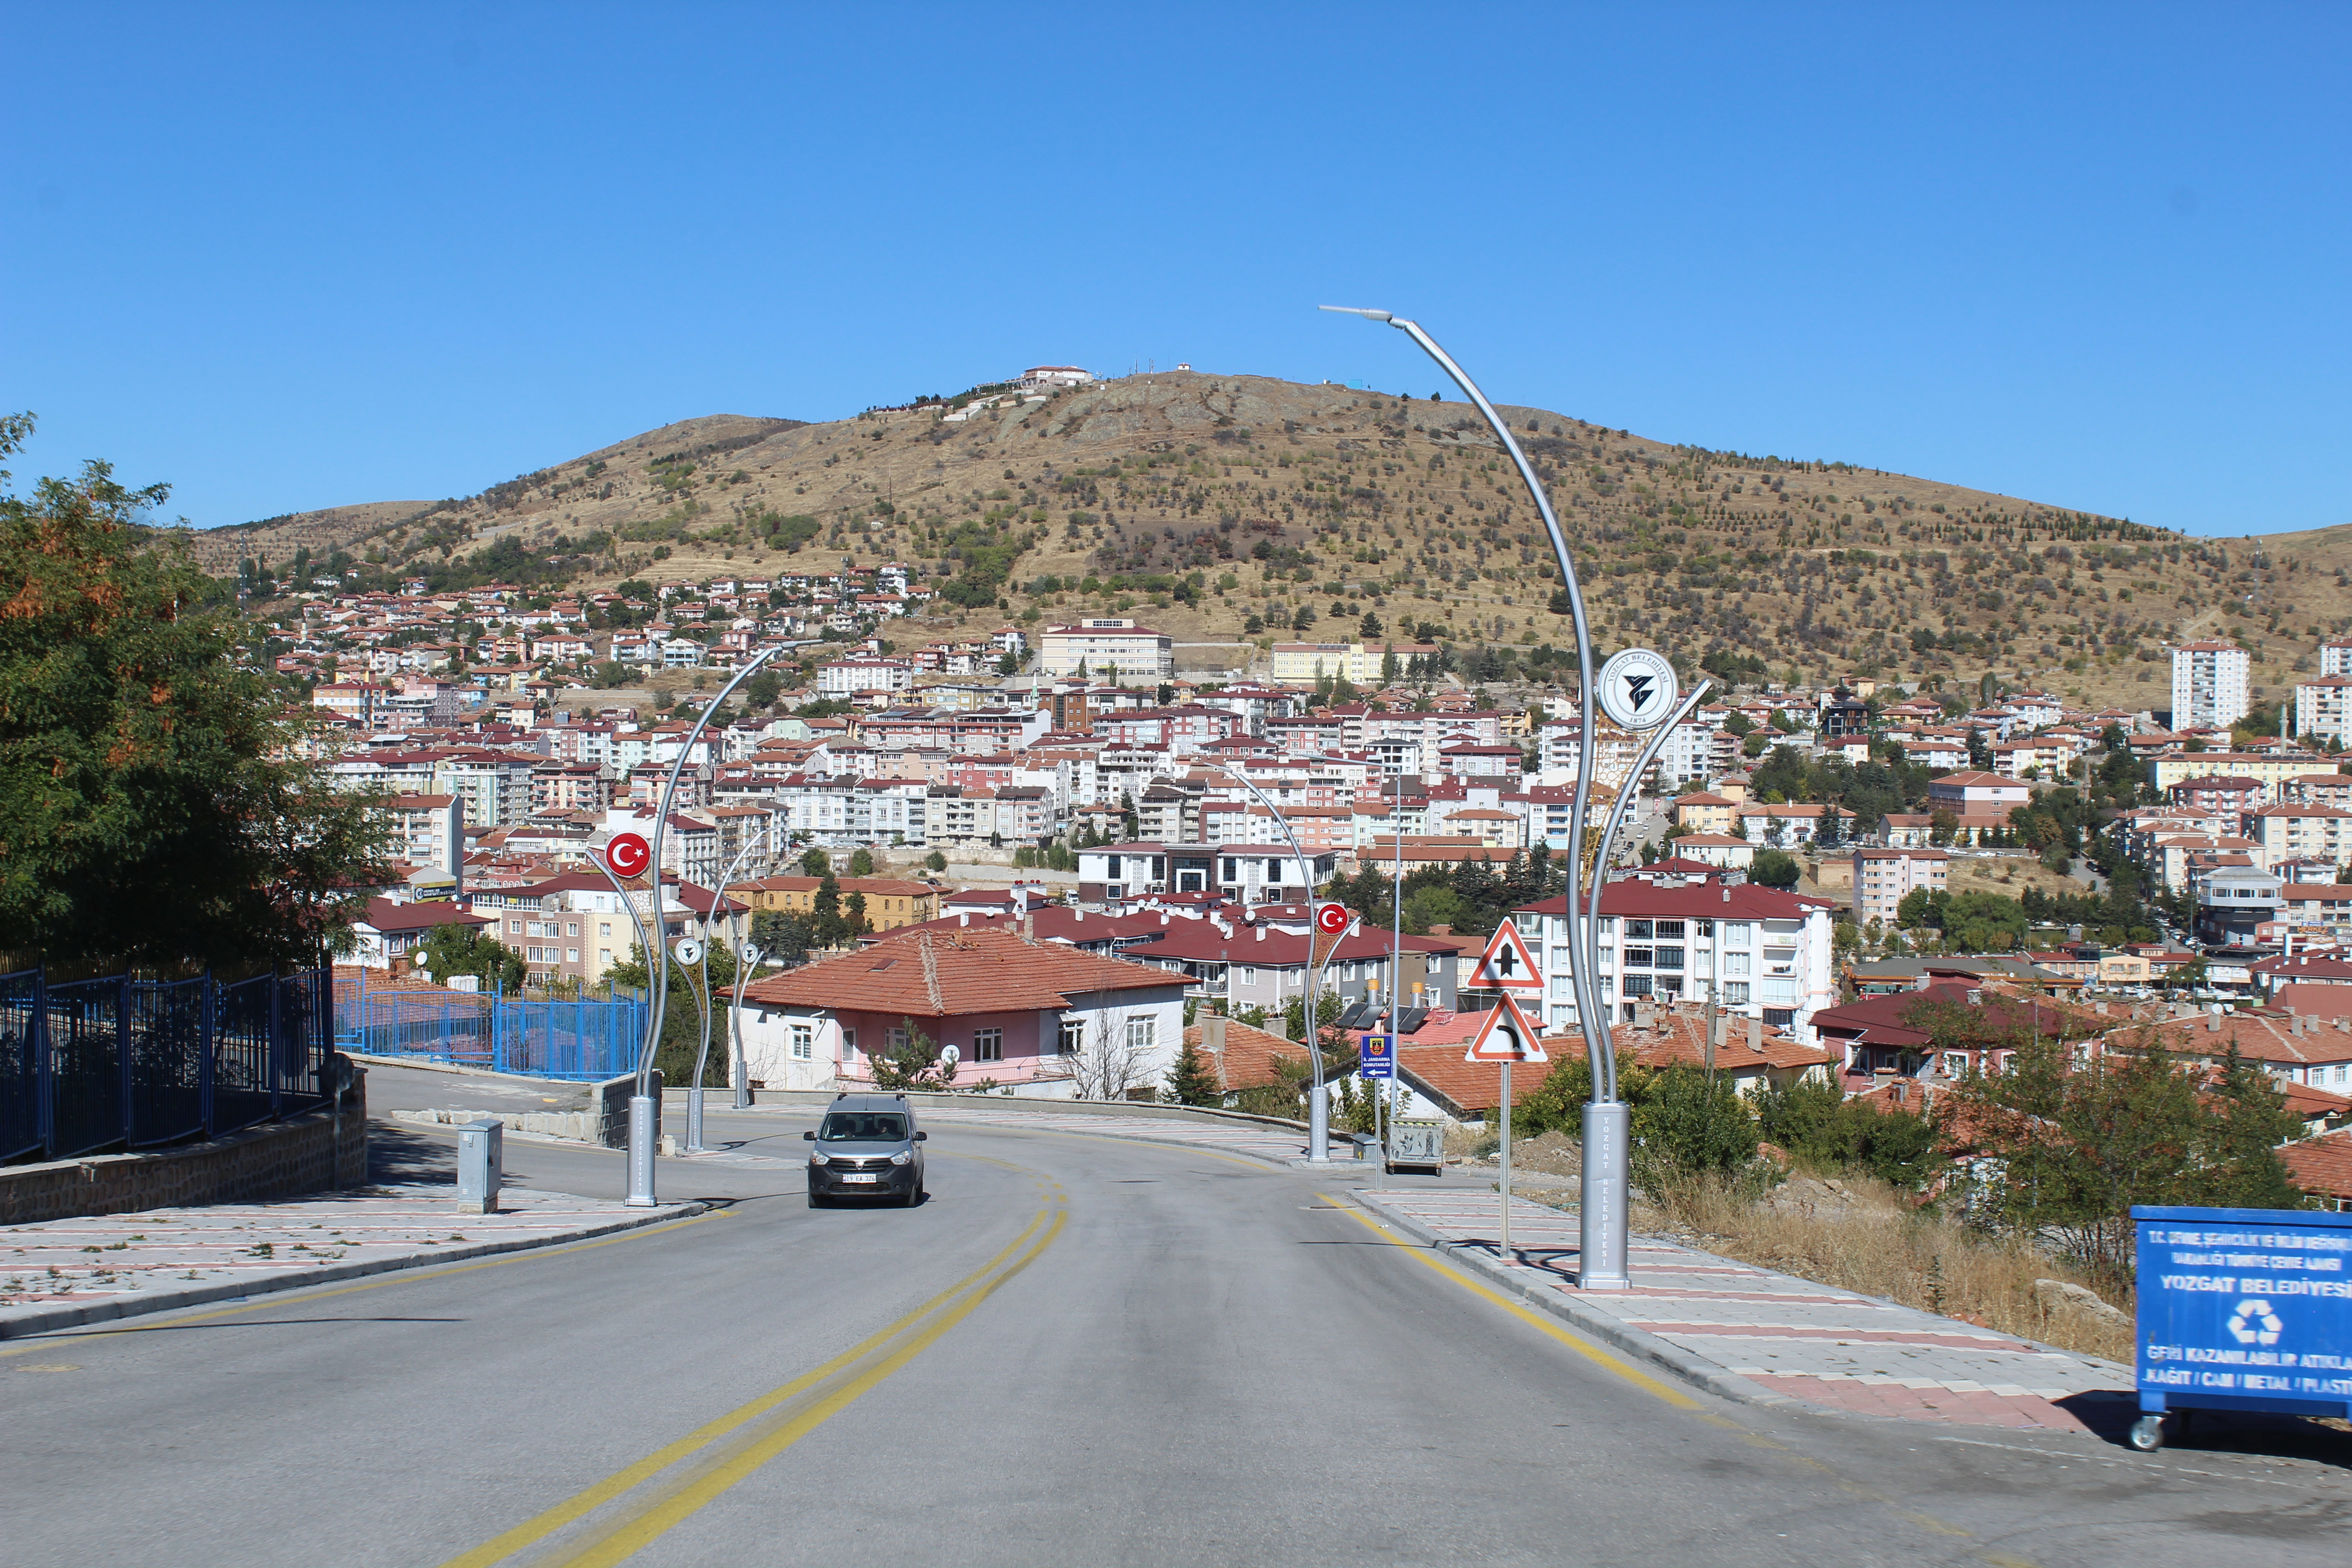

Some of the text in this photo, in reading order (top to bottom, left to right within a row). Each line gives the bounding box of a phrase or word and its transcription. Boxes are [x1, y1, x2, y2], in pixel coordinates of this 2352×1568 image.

[1607, 654, 1670, 683] YOZGAT BELEDİYESİ
[2160, 1275, 2352, 1298] YOZGAT BELEDİYESİ
[2243, 1374, 2292, 1391] METAL
